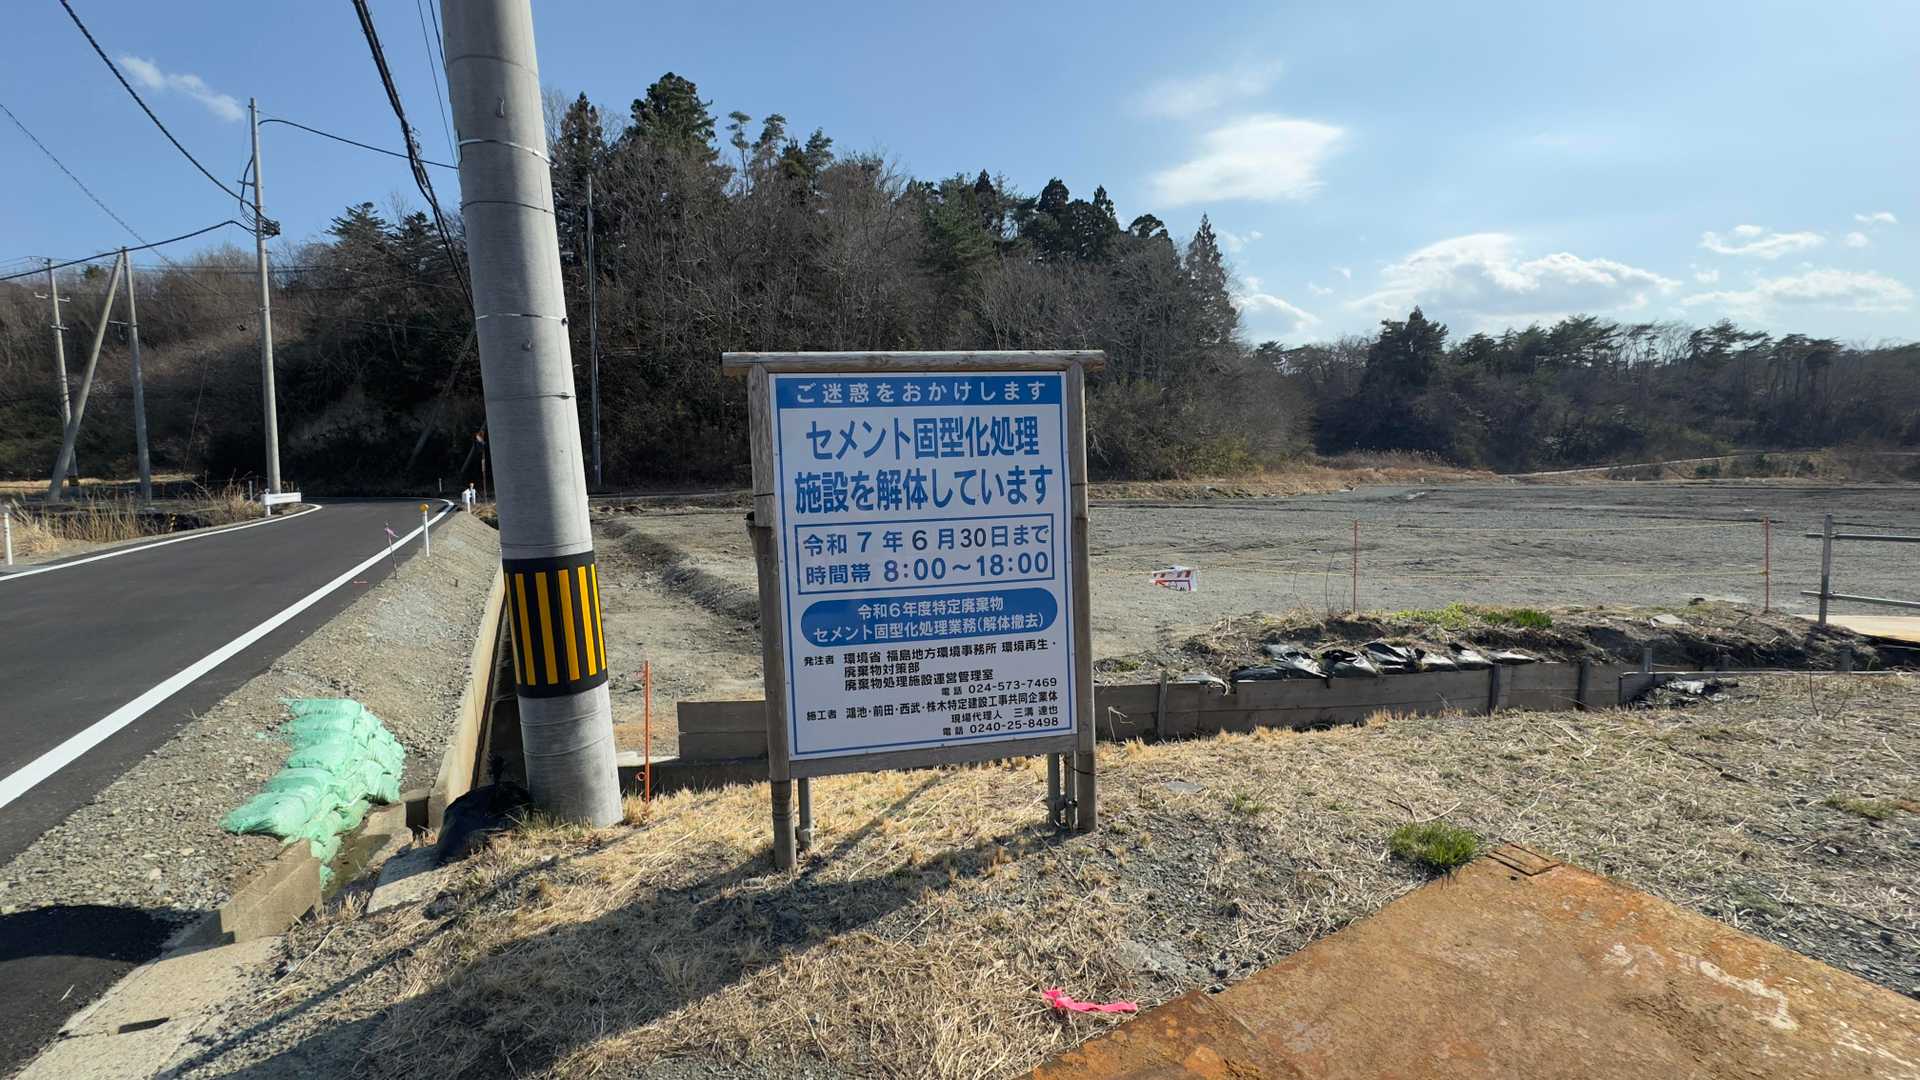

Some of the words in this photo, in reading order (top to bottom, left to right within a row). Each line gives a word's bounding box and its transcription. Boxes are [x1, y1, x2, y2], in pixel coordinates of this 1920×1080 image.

[797, 381, 1046, 403] ご迷惑をおかけします
[806, 415, 1040, 460] セメント固型化処理
[795, 464, 1053, 514] 施設を解体しています
[806, 562, 871, 586] 時間帯
[857, 596, 1004, 620] 令和6年度特定廃棄物
[804, 655, 834, 667] 発注者
[843, 651, 881, 665] 環境省
[887, 644, 997, 662] 福島地方環境事務所
[844, 661, 920, 678] 廃棄物対策部
[845, 668, 994, 691] 廃棄物処理施設運営管理室
[968, 677, 1057, 694] 024-573-7469
[806, 709, 837, 721] 施工者
[951, 709, 1003, 724] 現場代理人
[969, 716, 1059, 734] 0240-25-8498
